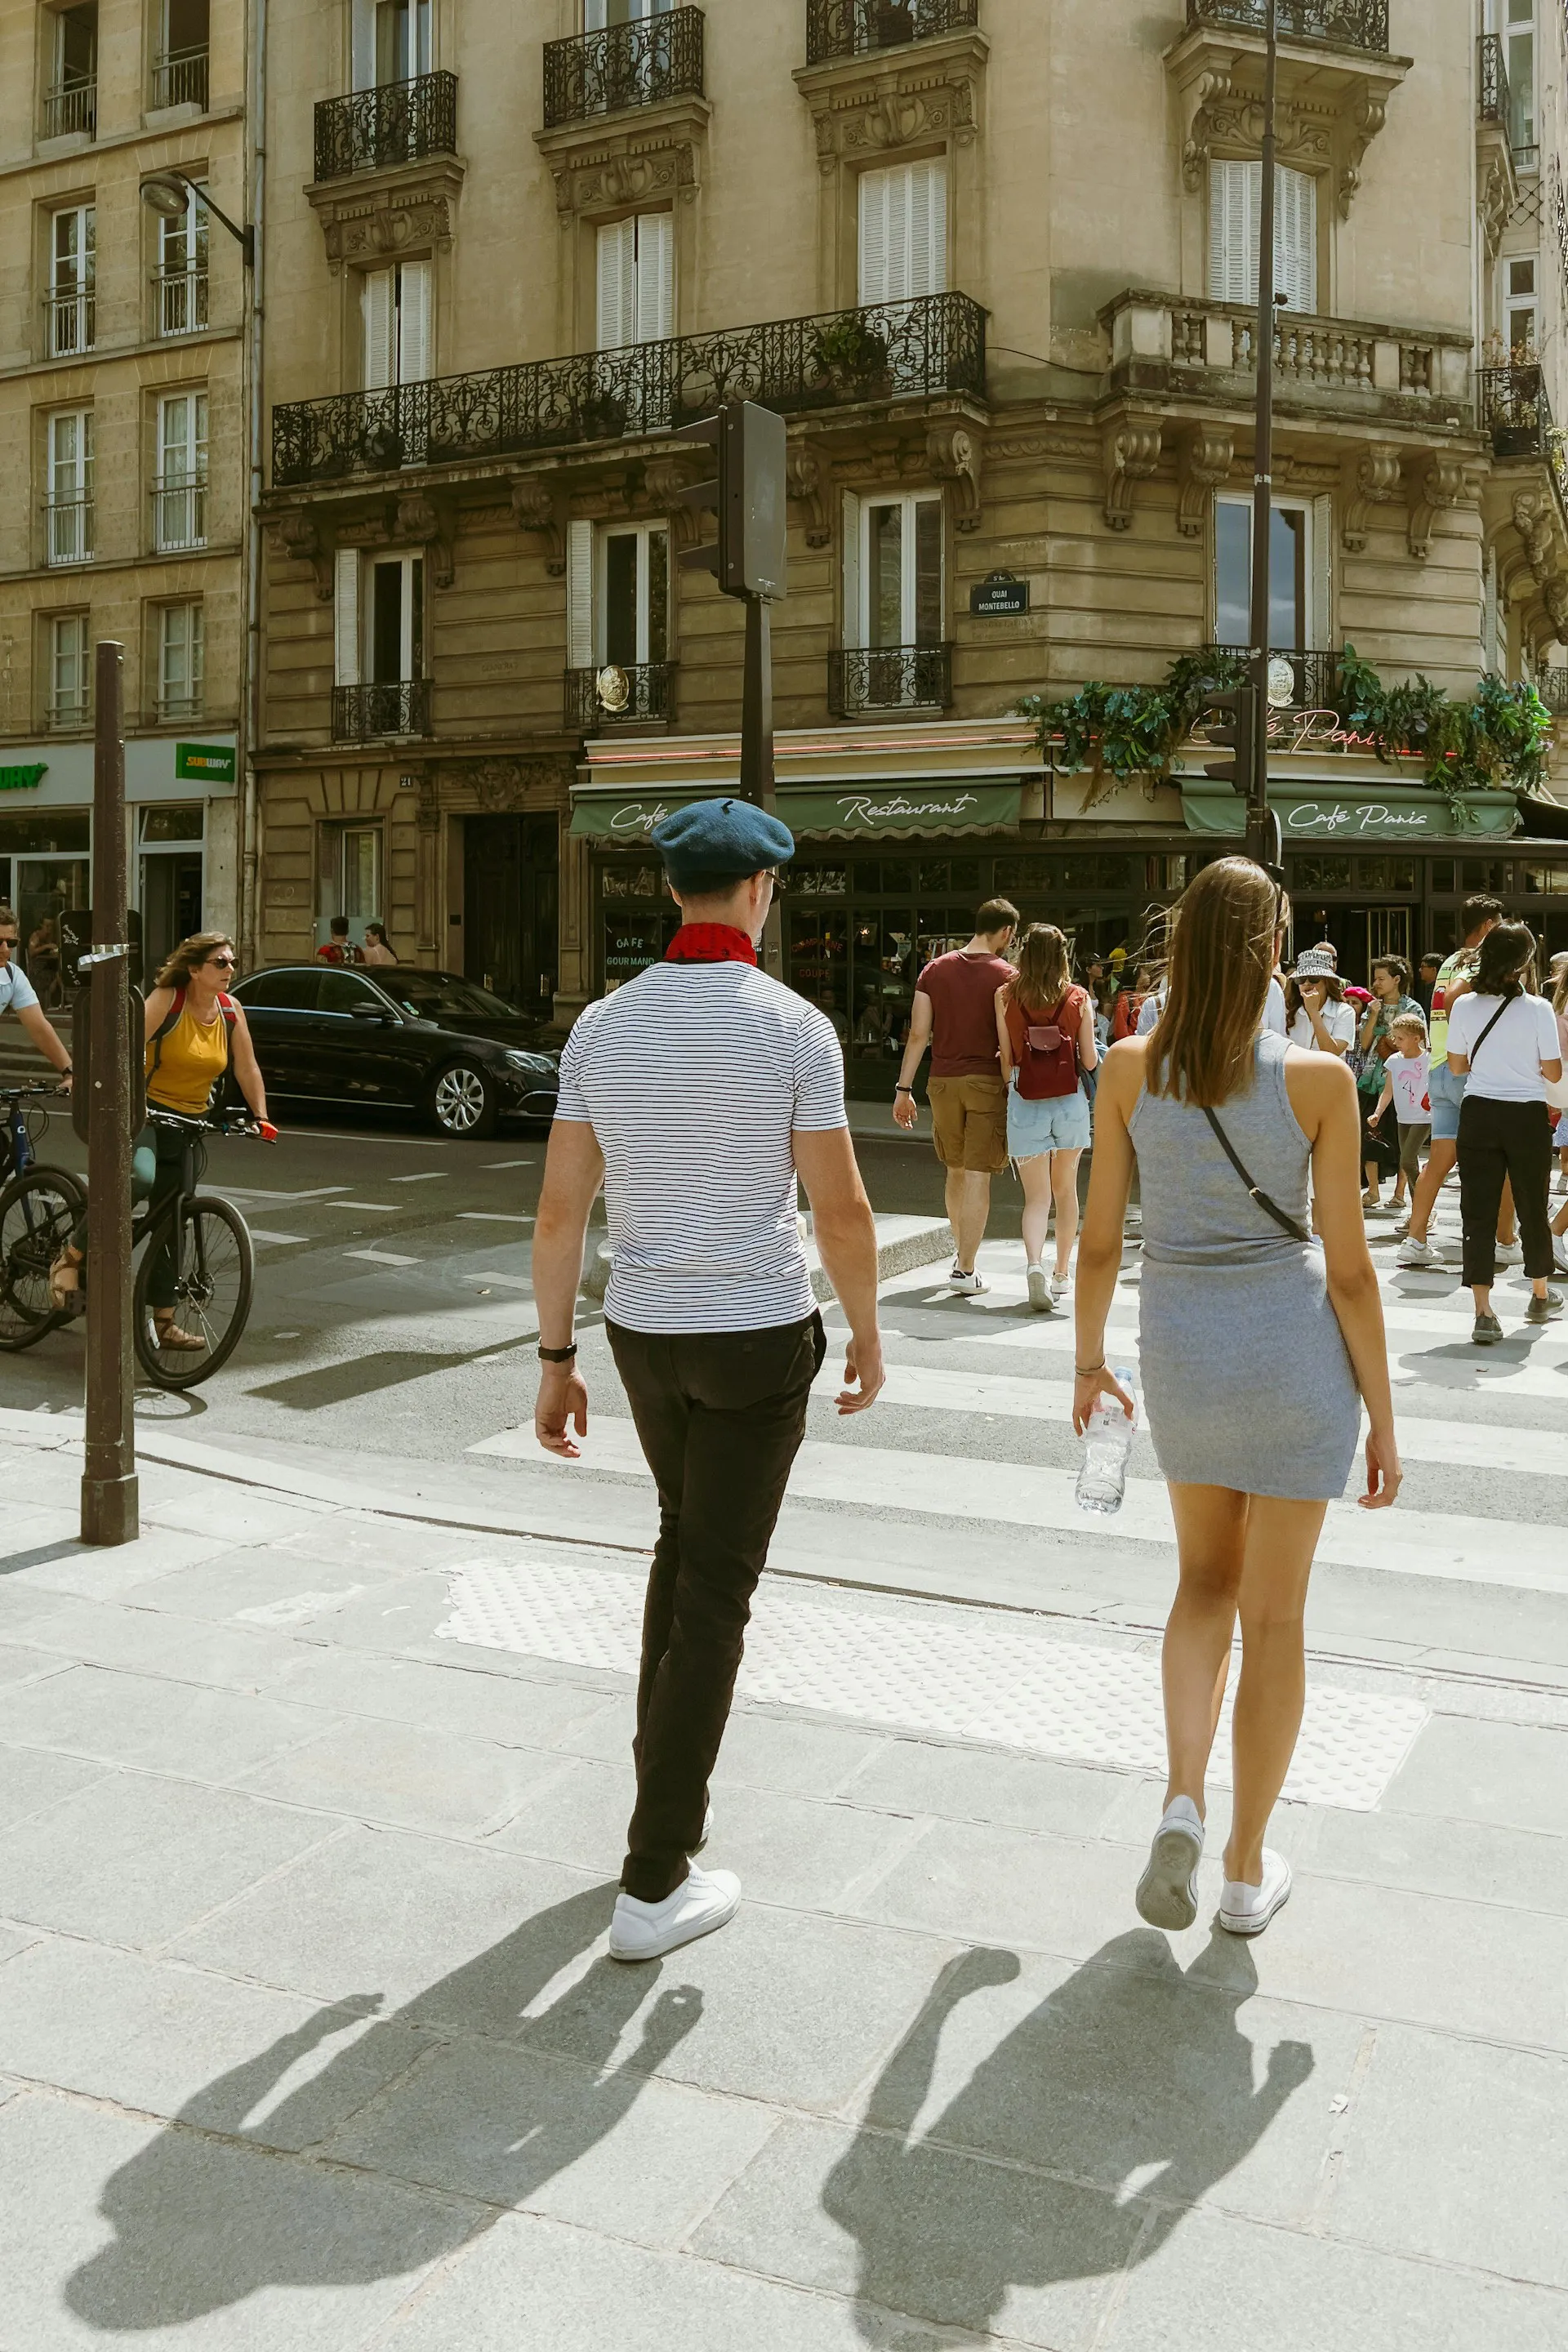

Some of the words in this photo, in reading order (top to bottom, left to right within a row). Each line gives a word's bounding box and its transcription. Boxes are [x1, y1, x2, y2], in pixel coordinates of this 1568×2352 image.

[991, 590, 1008, 599] QUAI
[978, 600, 1020, 611] MONTEBELLO
[186, 756, 231, 769] SUBWAY
[836, 793, 978, 825] Restaurant
[610, 803, 669, 831] Café
[1288, 804, 1350, 831] Café
[1356, 804, 1428, 830] Panis
[800, 969, 831, 978] COUPE
